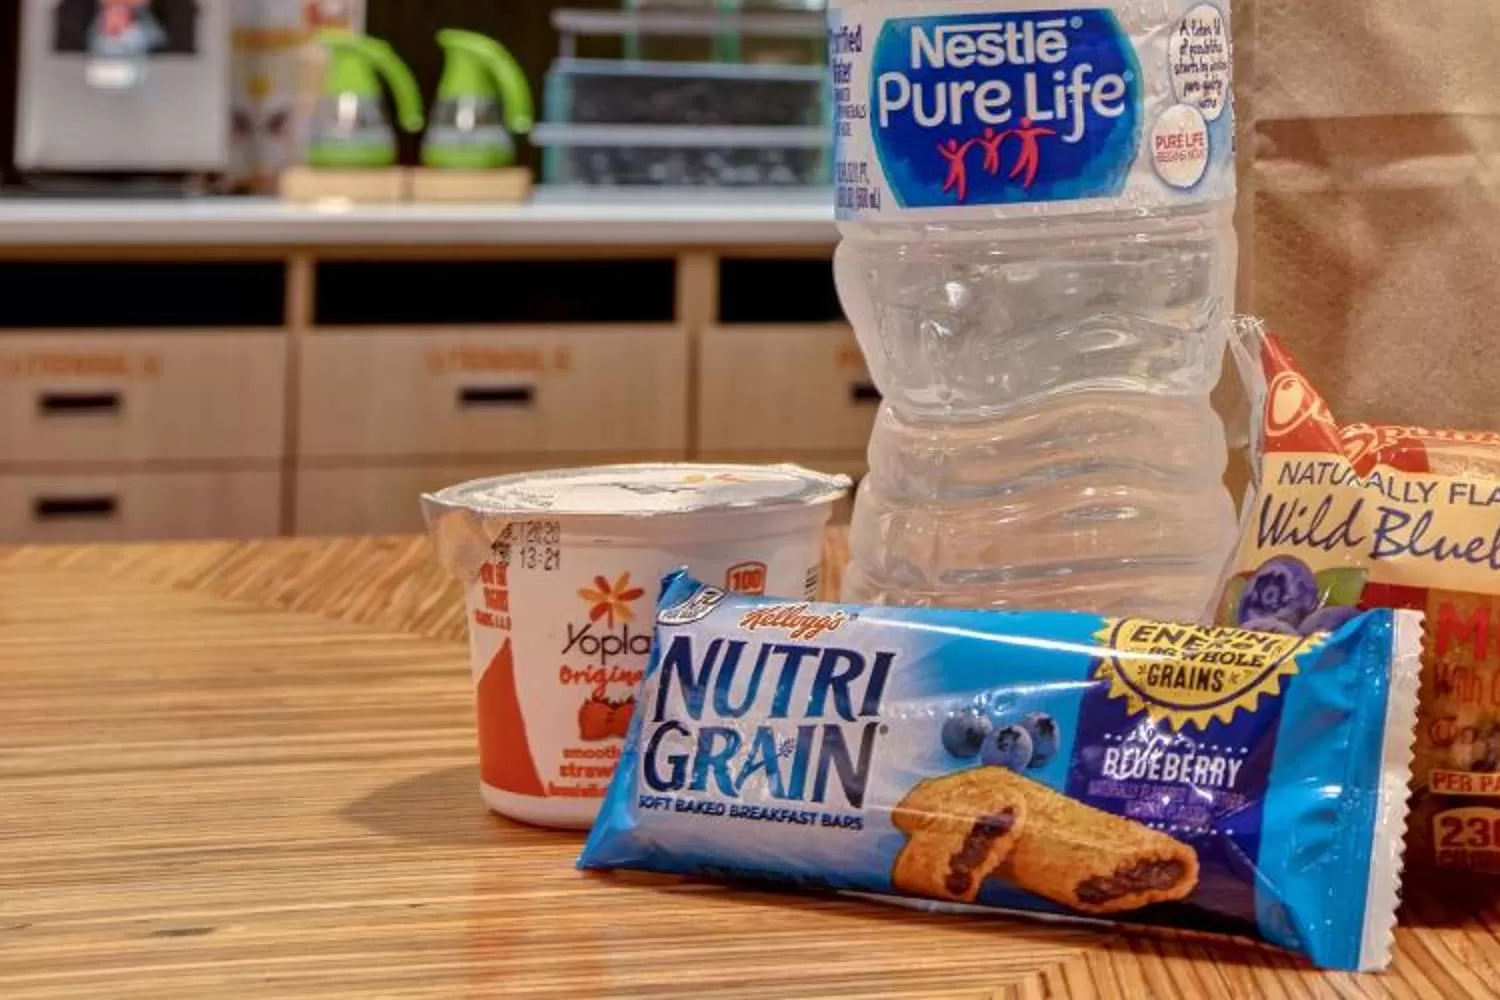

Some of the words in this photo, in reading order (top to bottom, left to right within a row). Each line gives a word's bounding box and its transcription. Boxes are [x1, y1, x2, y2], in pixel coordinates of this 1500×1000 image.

[877, 71, 1012, 128] Pure
[1024, 63, 1126, 144] Life
[1257, 495, 1366, 551] Wild
[741, 602, 844, 640] Kellogg's
[562, 622, 651, 666] Yopla
[652, 635, 896, 722] NUTRI
[1147, 663, 1225, 694] GRAINS
[643, 719, 881, 808] GRAIN
[1102, 747, 1243, 789] BLUEBERRY
[1432, 771, 1473, 793] PER
[675, 797, 725, 818] BAKED
[729, 804, 819, 827] BREAKFAST
[821, 813, 864, 831] BARS
